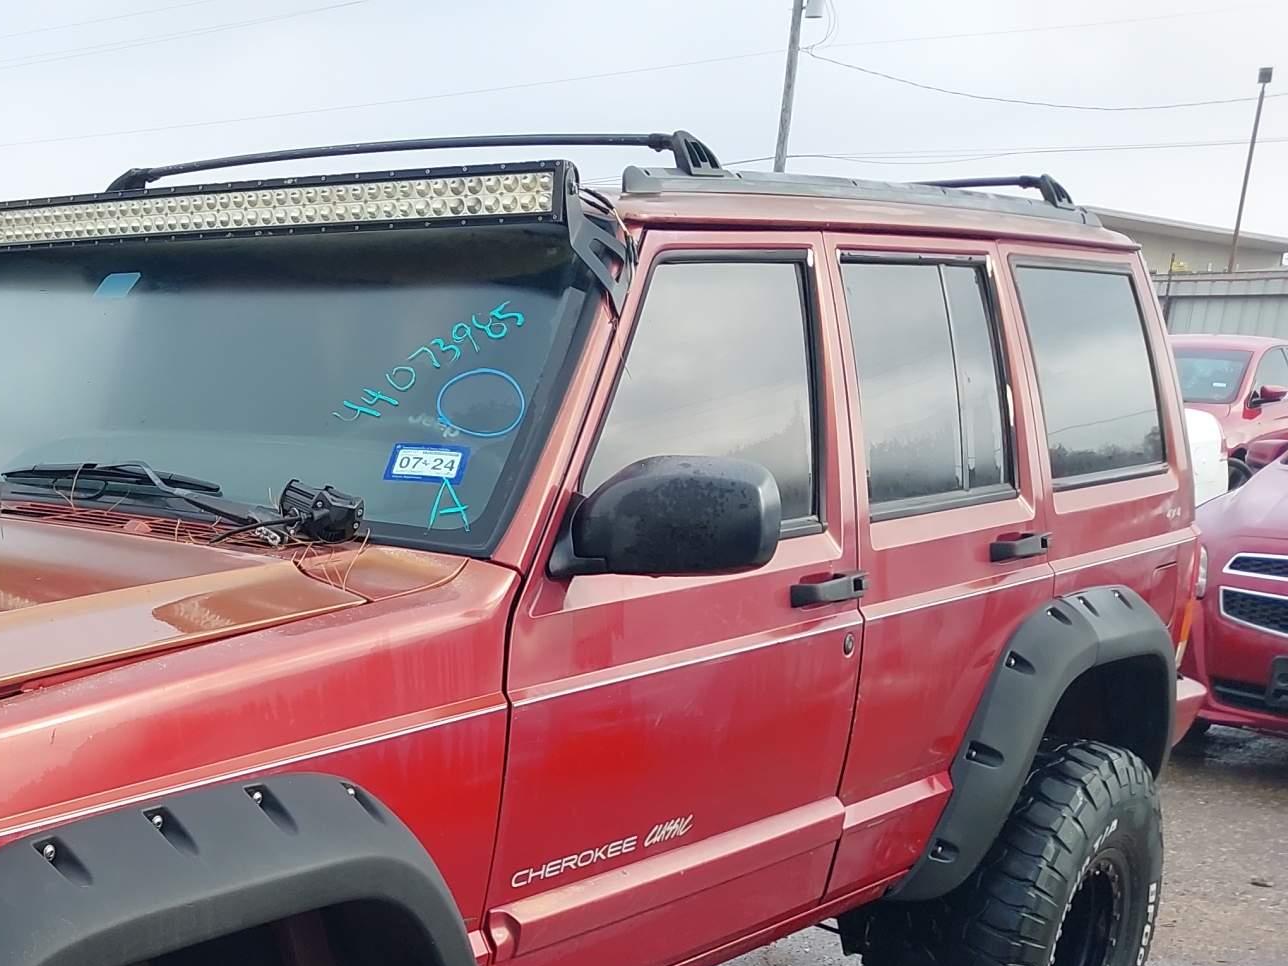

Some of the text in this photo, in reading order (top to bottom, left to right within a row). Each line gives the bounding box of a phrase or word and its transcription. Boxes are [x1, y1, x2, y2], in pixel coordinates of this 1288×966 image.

[332, 301, 525, 421] 44073985
[423, 476, 470, 535] A
[511, 836, 638, 888] CHEROKEE
